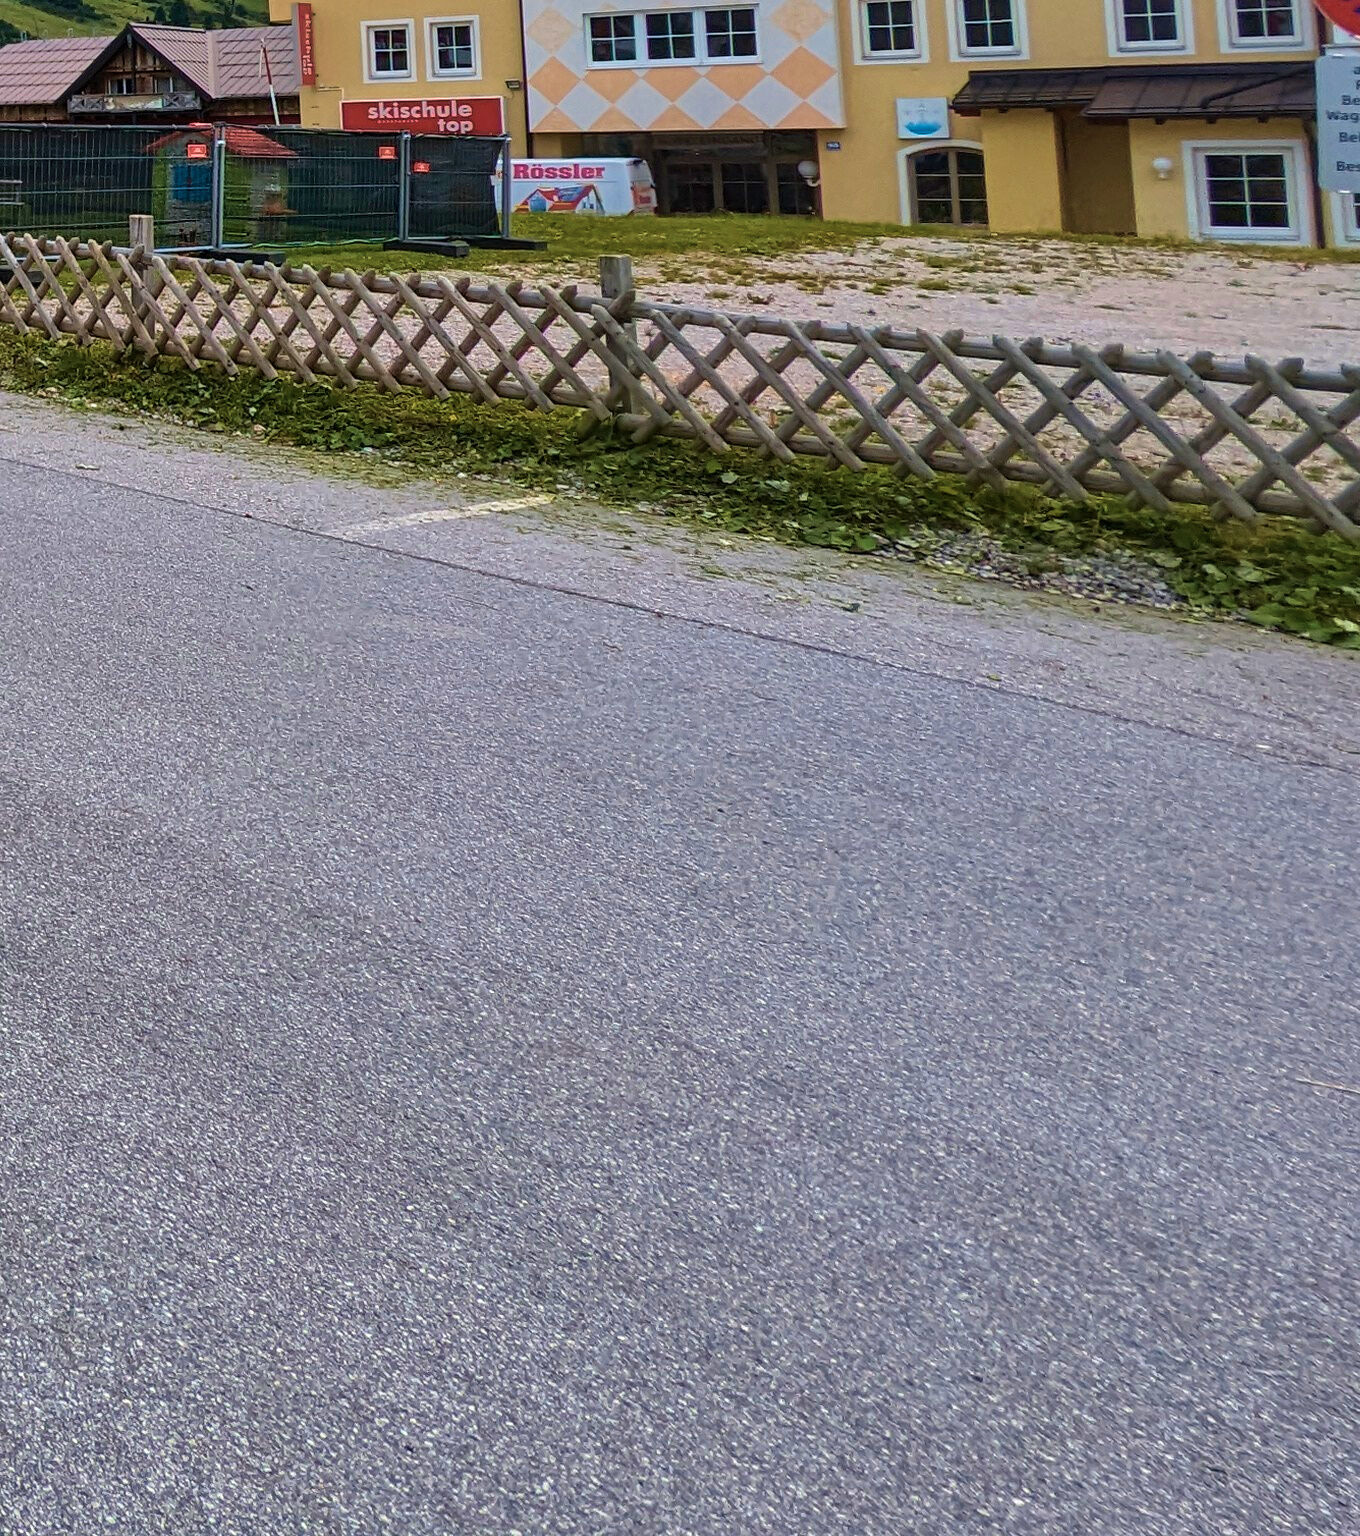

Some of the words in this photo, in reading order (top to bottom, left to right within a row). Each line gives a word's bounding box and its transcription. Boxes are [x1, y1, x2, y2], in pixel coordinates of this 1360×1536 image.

[367, 100, 473, 120] skischule
[437, 118, 474, 135] top
[513, 163, 606, 179] Rössler
